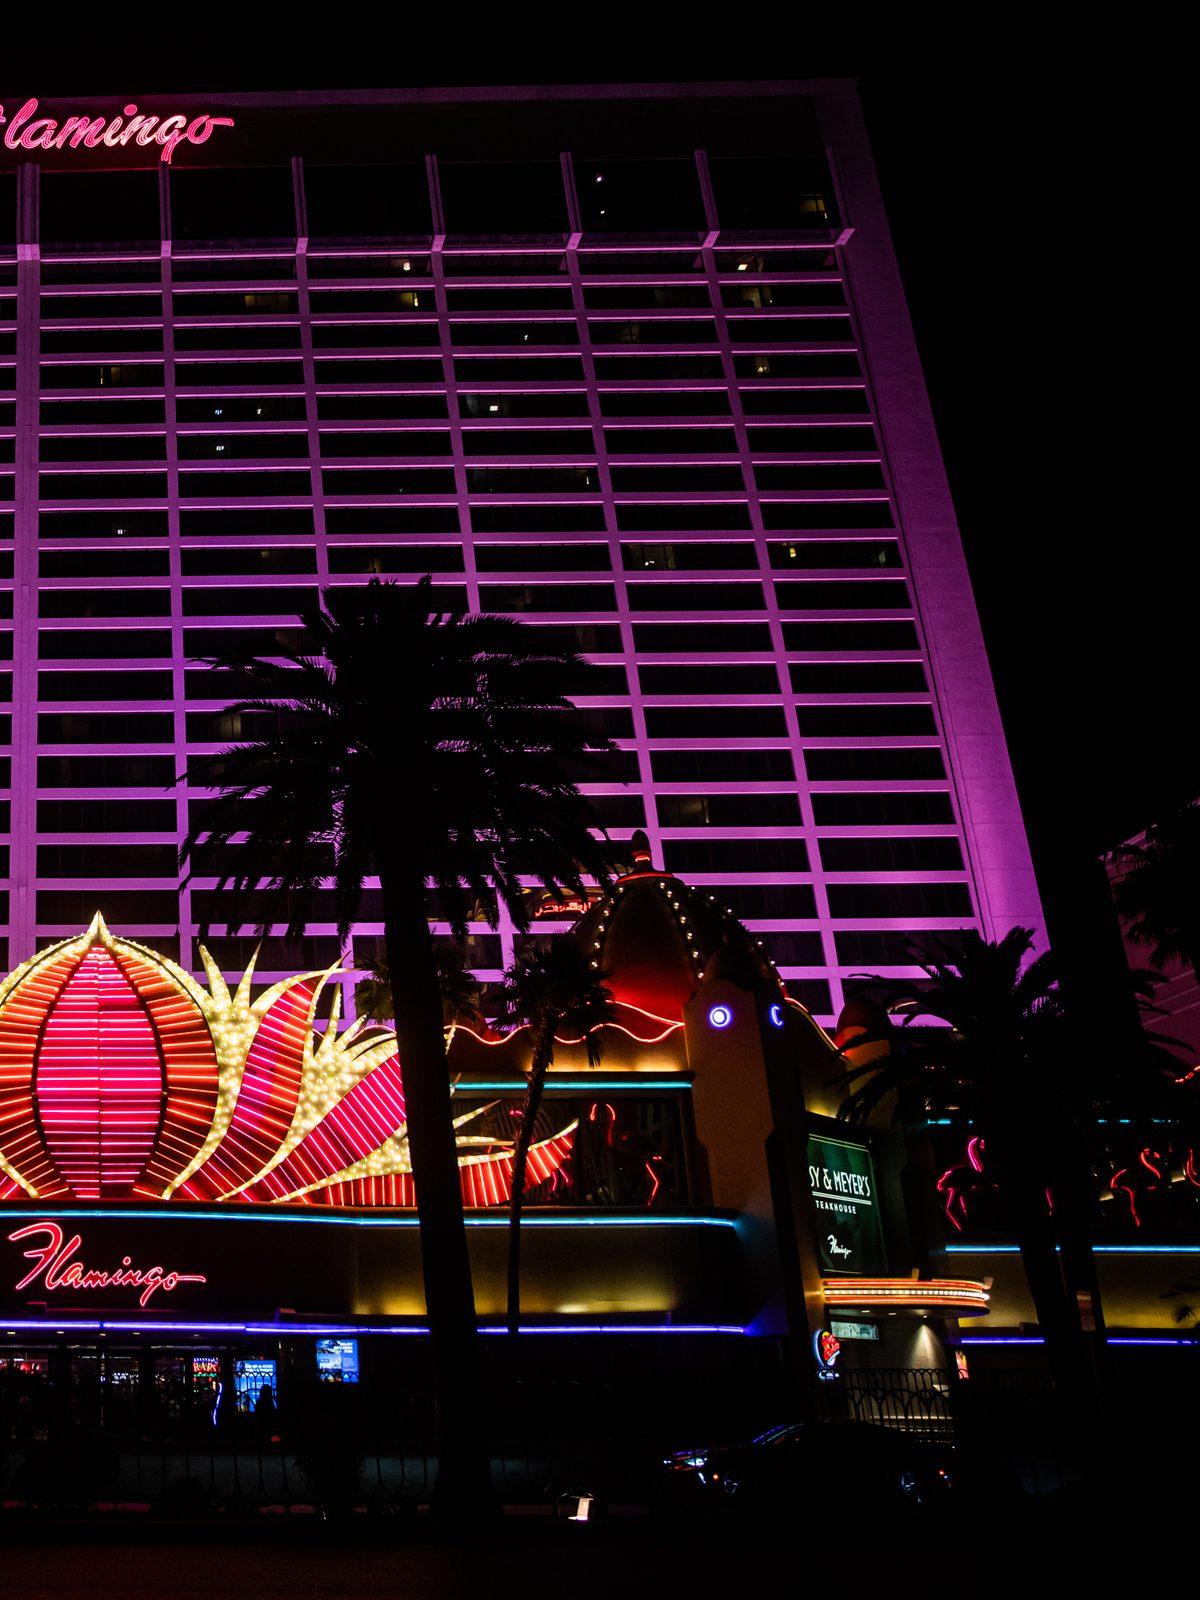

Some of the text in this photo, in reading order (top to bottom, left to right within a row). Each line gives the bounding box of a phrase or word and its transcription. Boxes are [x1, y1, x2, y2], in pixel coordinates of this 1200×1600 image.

[822, 1168, 832, 1191] &
[833, 1170, 870, 1197] MEYER'S
[8, 1222, 206, 1307] Flamingo
